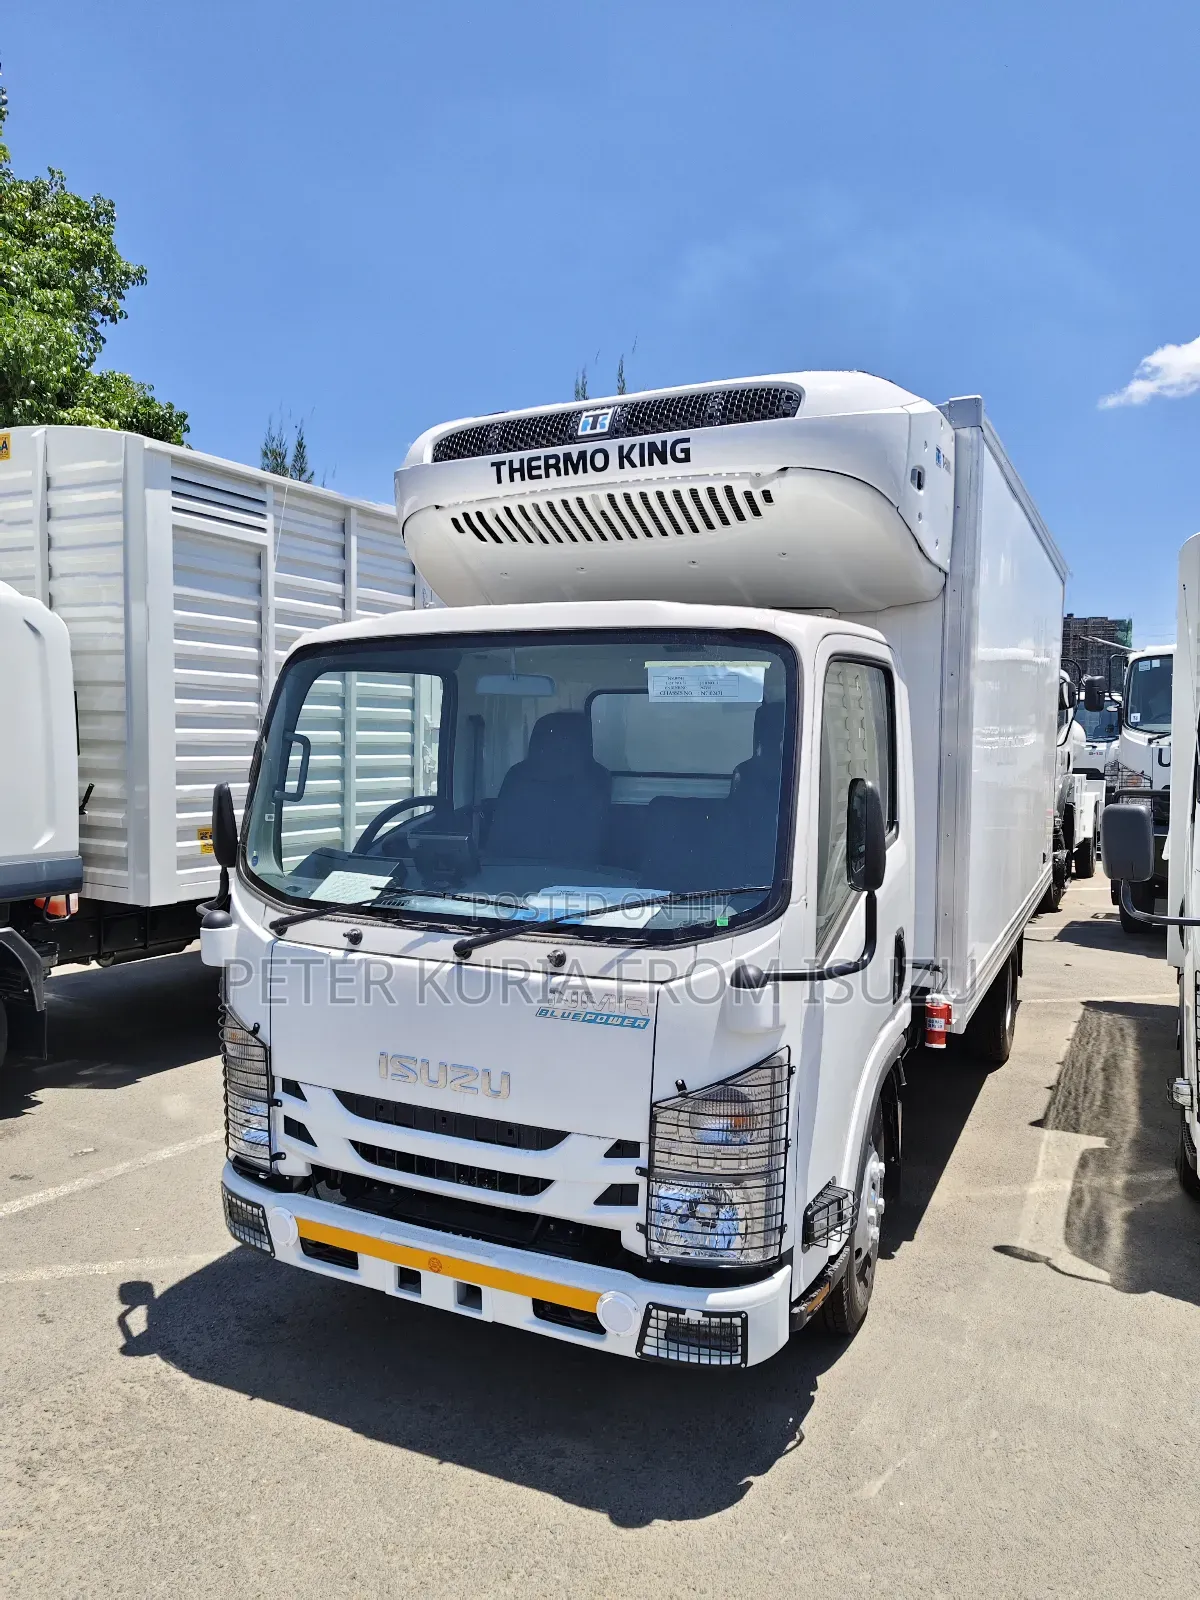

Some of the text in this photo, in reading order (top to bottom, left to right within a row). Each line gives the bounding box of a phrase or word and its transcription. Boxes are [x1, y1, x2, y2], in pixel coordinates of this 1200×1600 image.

[491, 437, 691, 484] THERMO KING
[537, 1008, 648, 1029] BLUEPOWER
[378, 1051, 511, 1100] ISUZU
